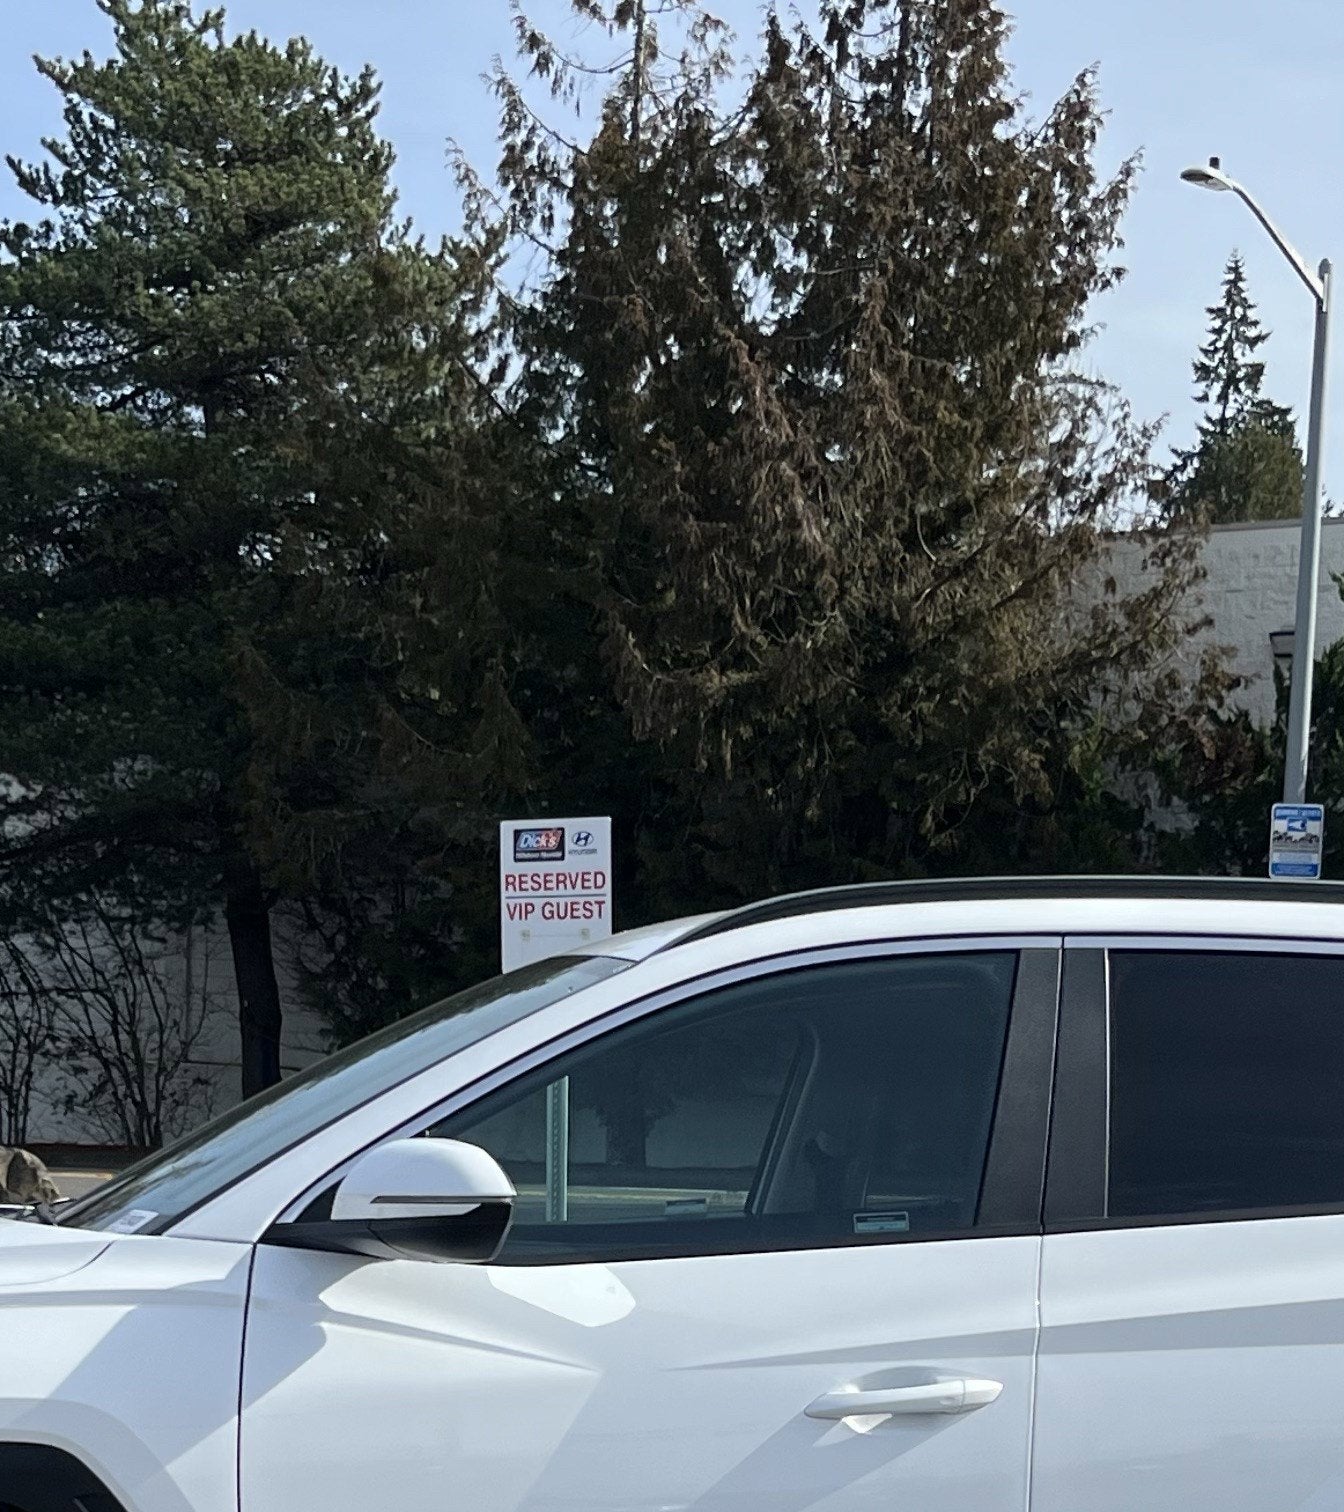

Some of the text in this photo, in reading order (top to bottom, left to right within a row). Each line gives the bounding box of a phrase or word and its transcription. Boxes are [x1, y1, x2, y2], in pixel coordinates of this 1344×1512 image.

[505, 871, 606, 892] RESERVED
[507, 901, 606, 921] VIP GUEST
